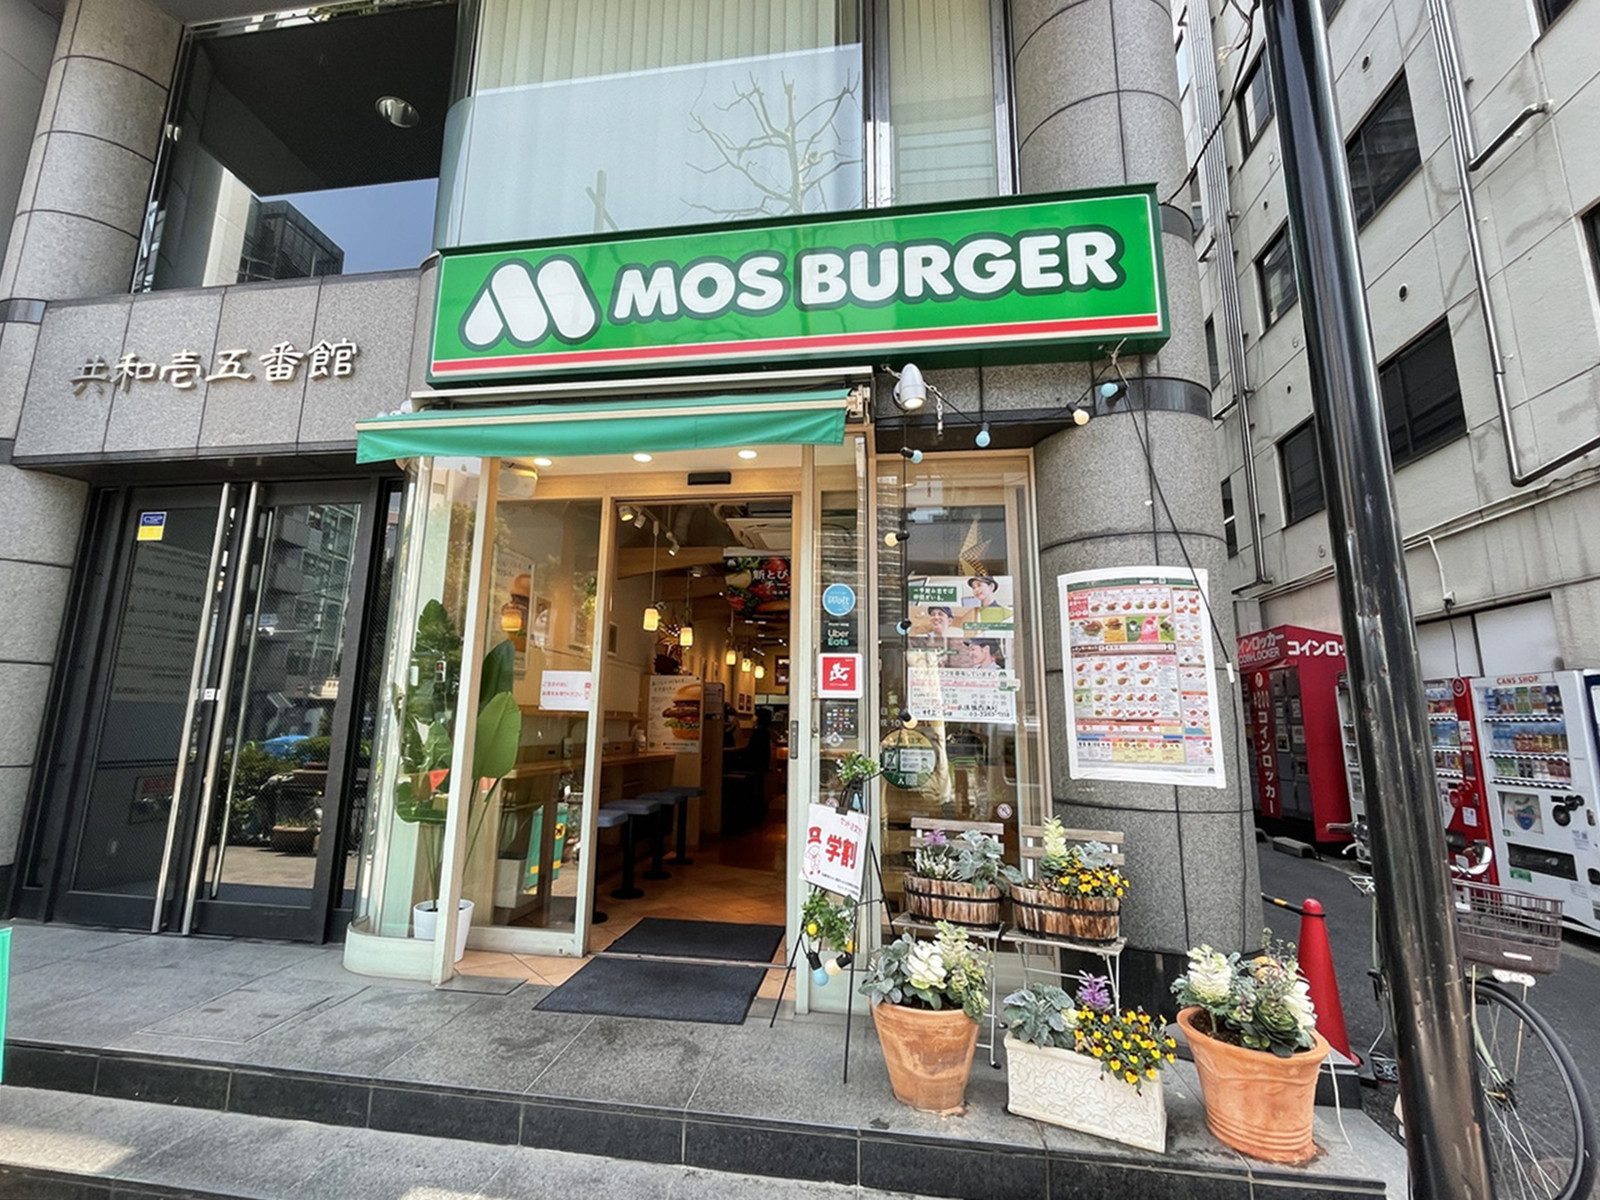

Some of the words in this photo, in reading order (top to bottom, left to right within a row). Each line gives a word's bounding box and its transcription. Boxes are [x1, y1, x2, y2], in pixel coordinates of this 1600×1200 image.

[613, 254, 785, 321] MOS
[799, 231, 1118, 306] BURGER
[70, 338, 357, 396] 共和壱五番館
[827, 629, 850, 638] Uber
[1496, 676, 1516, 686] CANS
[1518, 674, 1539, 684] SHOP
[1257, 711, 1276, 814] コインロッカー
